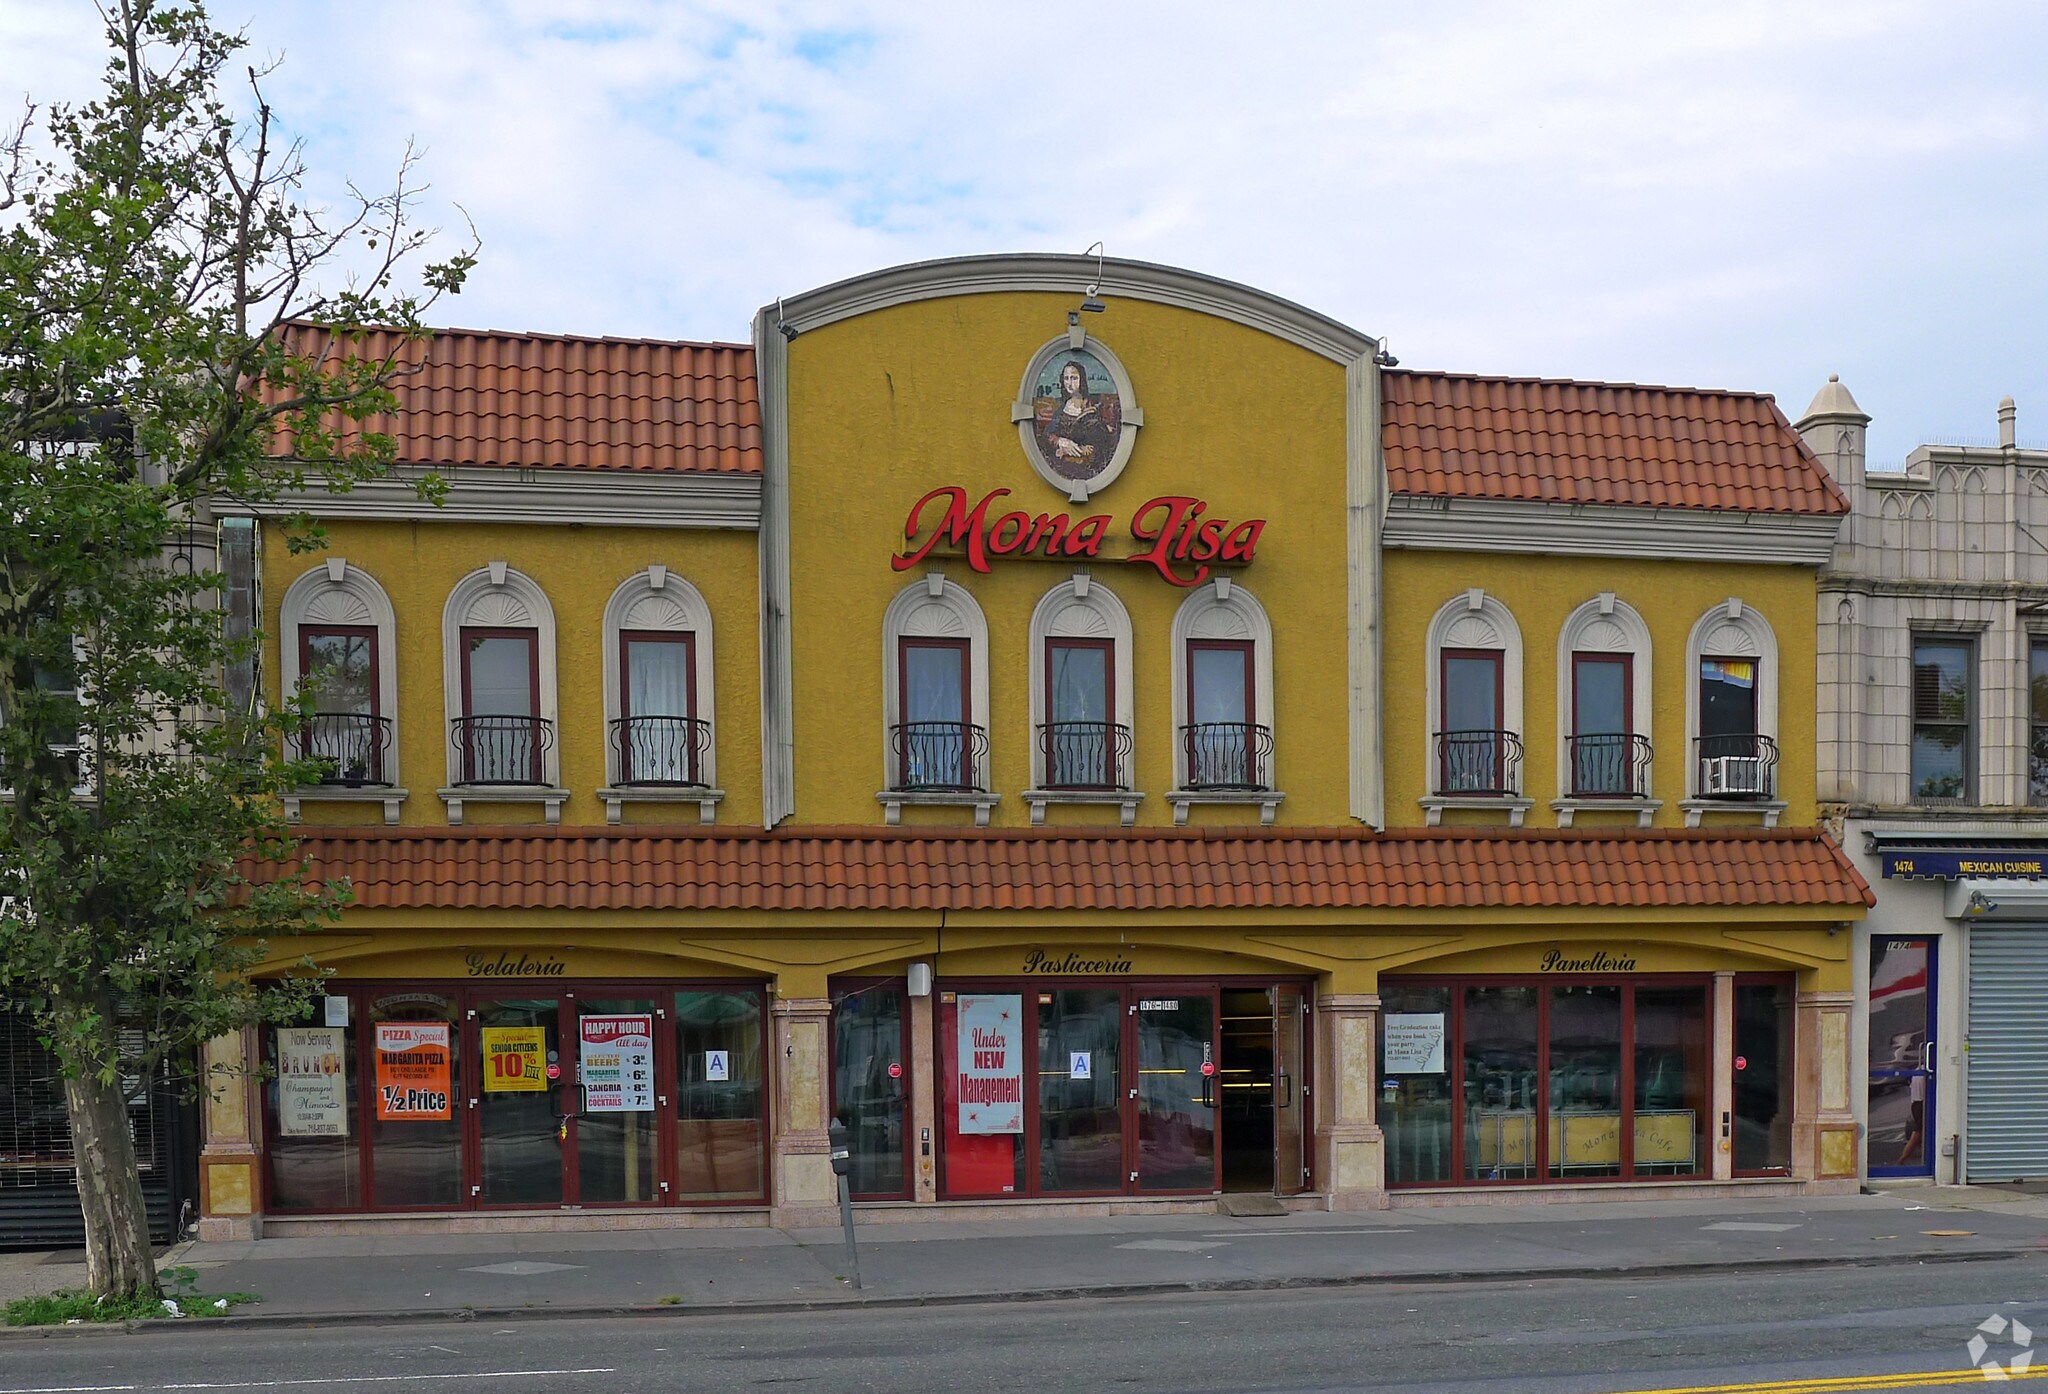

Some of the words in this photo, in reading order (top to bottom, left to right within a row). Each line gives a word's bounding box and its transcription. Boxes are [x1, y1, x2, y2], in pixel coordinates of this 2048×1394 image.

[891, 486, 1113, 574] Mona
[1126, 496, 1267, 588] Lisa
[1894, 860, 1914, 873] 1474
[1959, 861, 2003, 873] MEXICAN
[2004, 862, 2041, 873] CUISINE
[466, 951, 565, 976] Gelateria
[1023, 949, 1132, 974] Pasticceria
[1541, 949, 1636, 972] Panetteria
[585, 1022, 616, 1035] HAPPY
[618, 1022, 646, 1034] HOUR
[291, 1031, 306, 1046] Now
[307, 1031, 331, 1049] Serving
[382, 1030, 412, 1041] PIZZA
[413, 1029, 445, 1045] Special
[500, 1033, 528, 1043] Special
[616, 1039, 629, 1048] All
[632, 1039, 648, 1049] day
[972, 1027, 1006, 1048] Under
[491, 1044, 512, 1053] SENIOR
[512, 1043, 538, 1052] CITIZENS
[282, 1052, 340, 1074] BRUNCH
[381, 1053, 424, 1065] MARGARITA
[425, 1053, 445, 1065] PIZZA
[586, 1058, 620, 1067] BEERS
[710, 1054, 724, 1071] A
[974, 1051, 1005, 1069] NEW
[1074, 1055, 1087, 1072] A
[524, 1065, 541, 1080] OFF
[286, 1080, 333, 1095] Champagne
[588, 1084, 622, 1092] SANGRIA
[960, 1073, 1020, 1107] Management
[407, 1088, 447, 1112] Price
[588, 1099, 622, 1107] COCKTAILS
[1583, 1130, 1615, 1152] Mona
